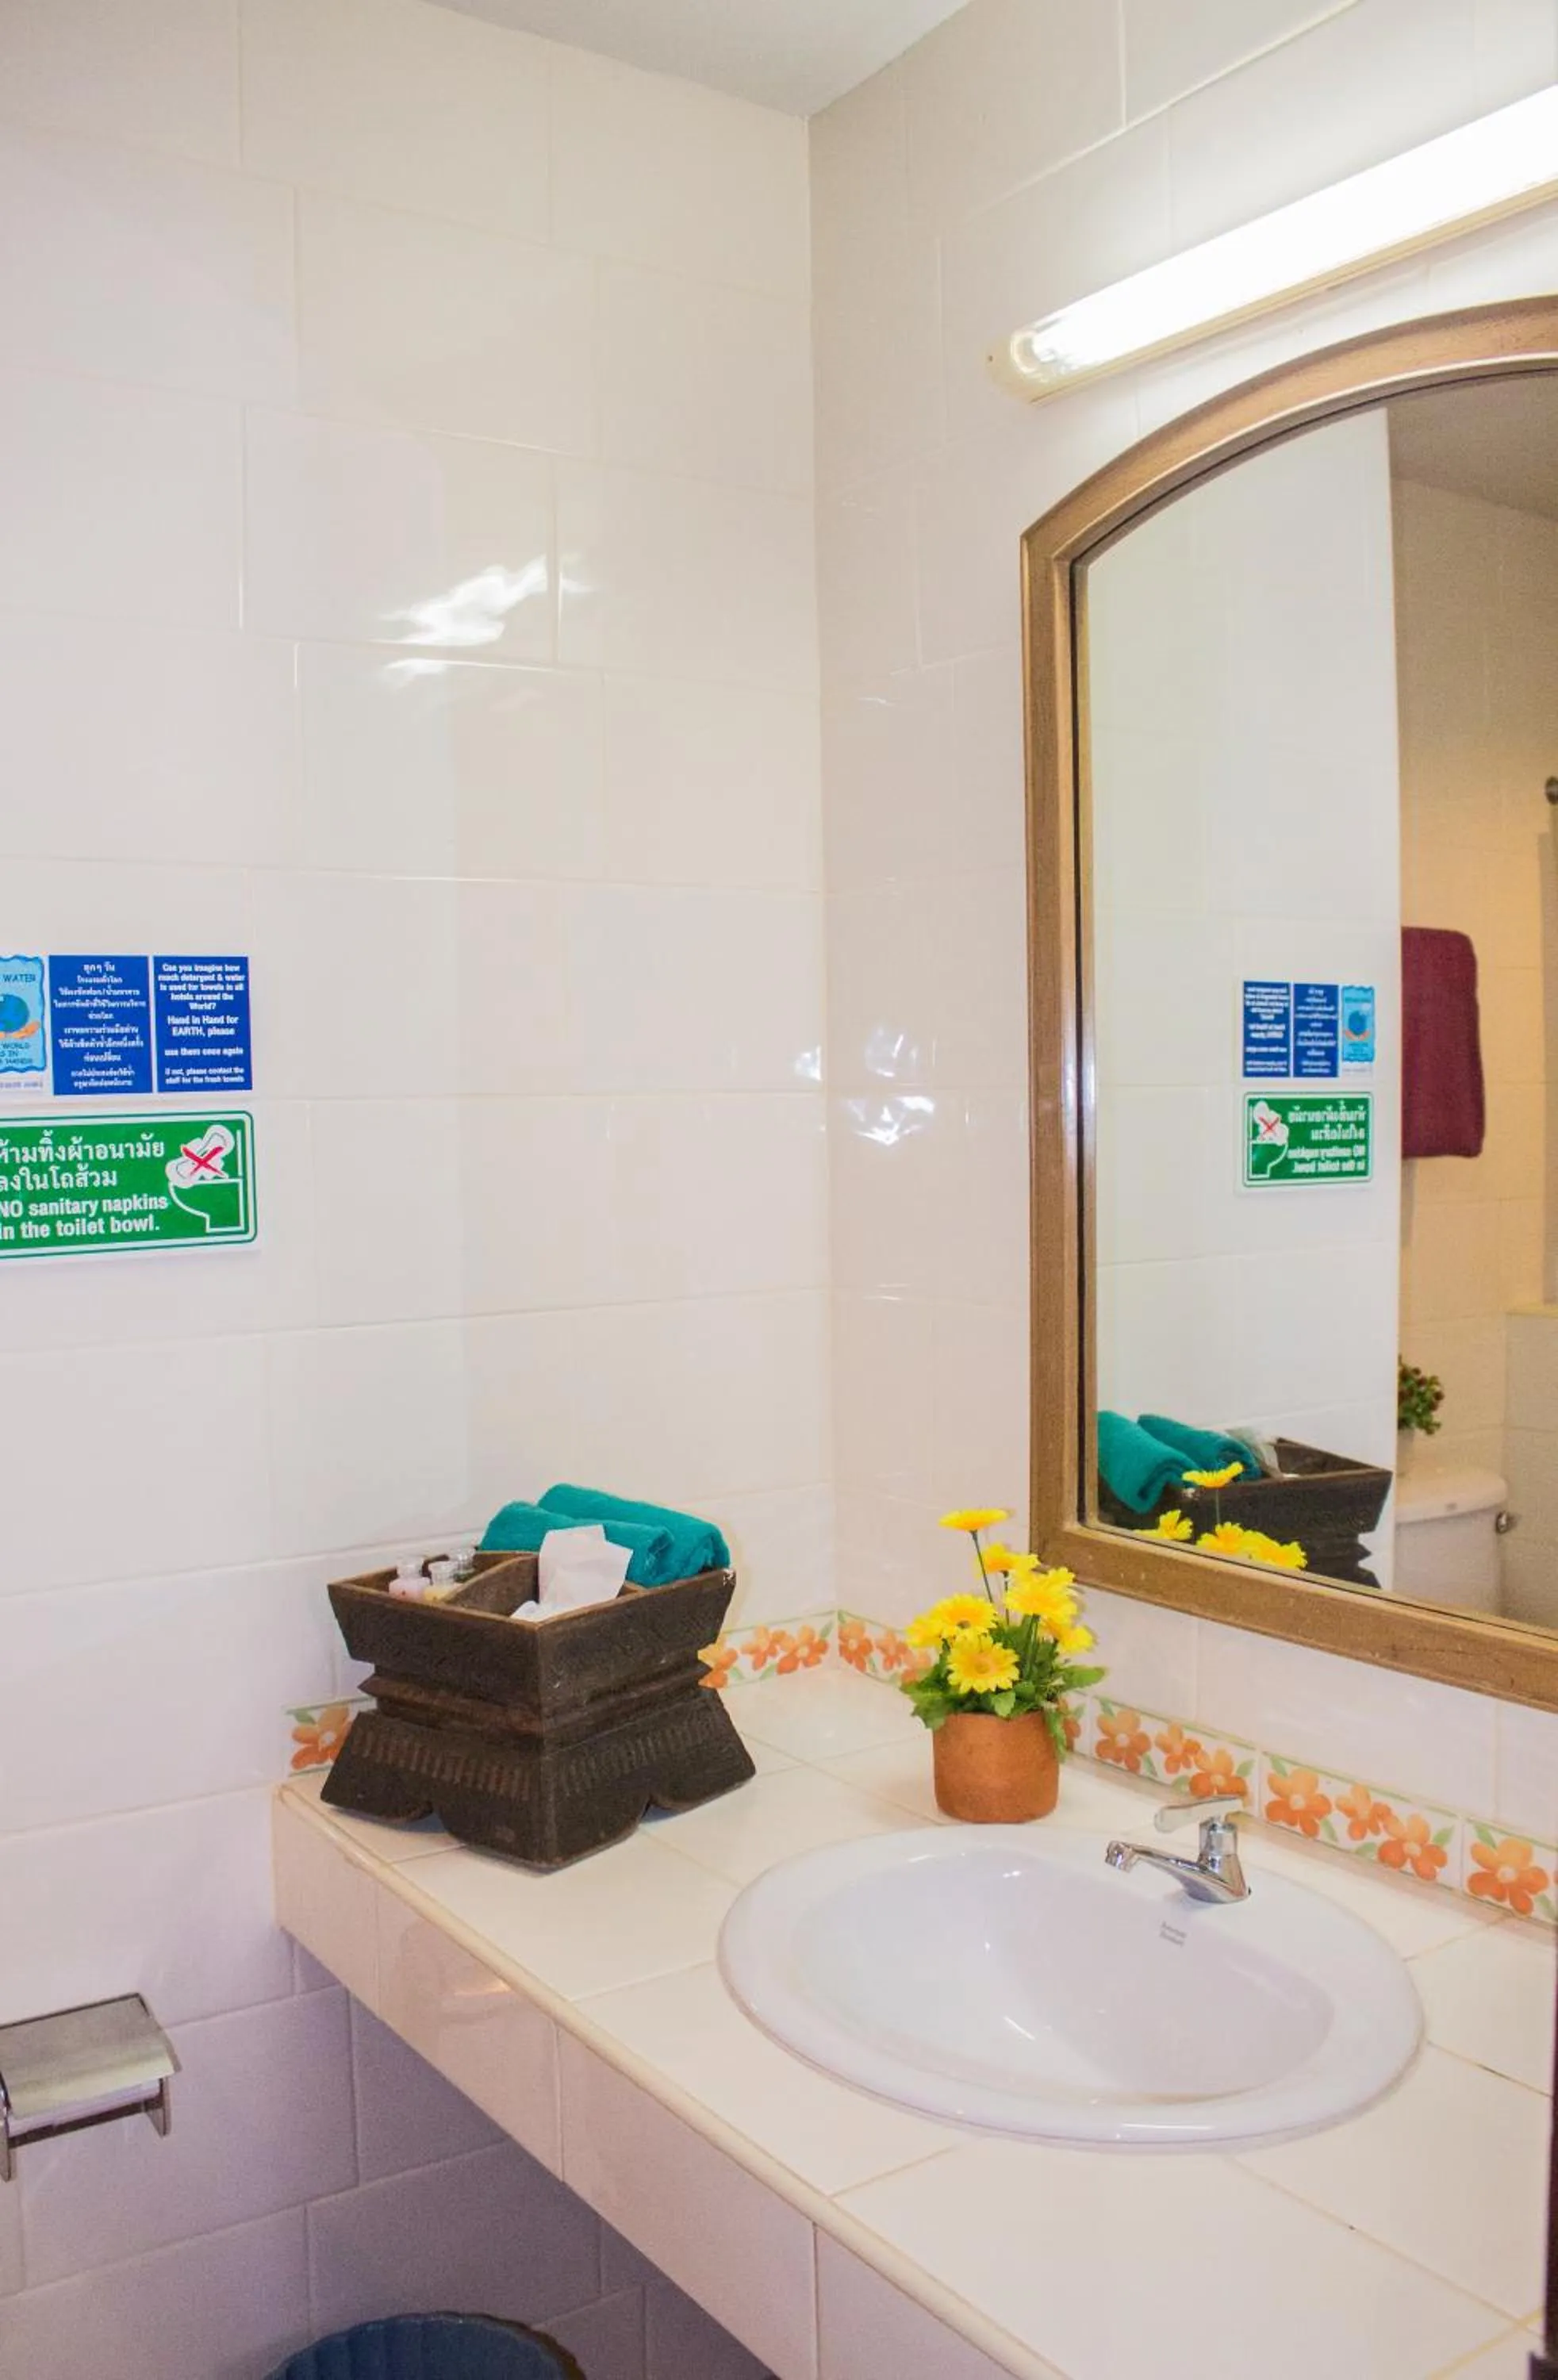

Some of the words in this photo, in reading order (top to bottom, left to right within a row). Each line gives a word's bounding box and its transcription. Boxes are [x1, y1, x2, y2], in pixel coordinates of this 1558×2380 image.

[178, 965, 192, 973] you
[194, 964, 223, 973] imagine
[2, 973, 36, 983] WATER
[167, 1015, 190, 1024] Hand
[191, 1015, 200, 1024] in
[202, 1015, 224, 1024] Hand
[226, 1015, 239, 1024] for
[171, 1027, 205, 1037] EARTH,
[207, 1027, 235, 1038] please
[222, 1047, 244, 1058] again
[29, 1197, 98, 1218] sanitary
[102, 1193, 168, 1215] napkins
[0, 1223, 14, 1239] in
[20, 1221, 50, 1239] the
[56, 1218, 105, 1237] toilet
[110, 1214, 160, 1234] bowl.
